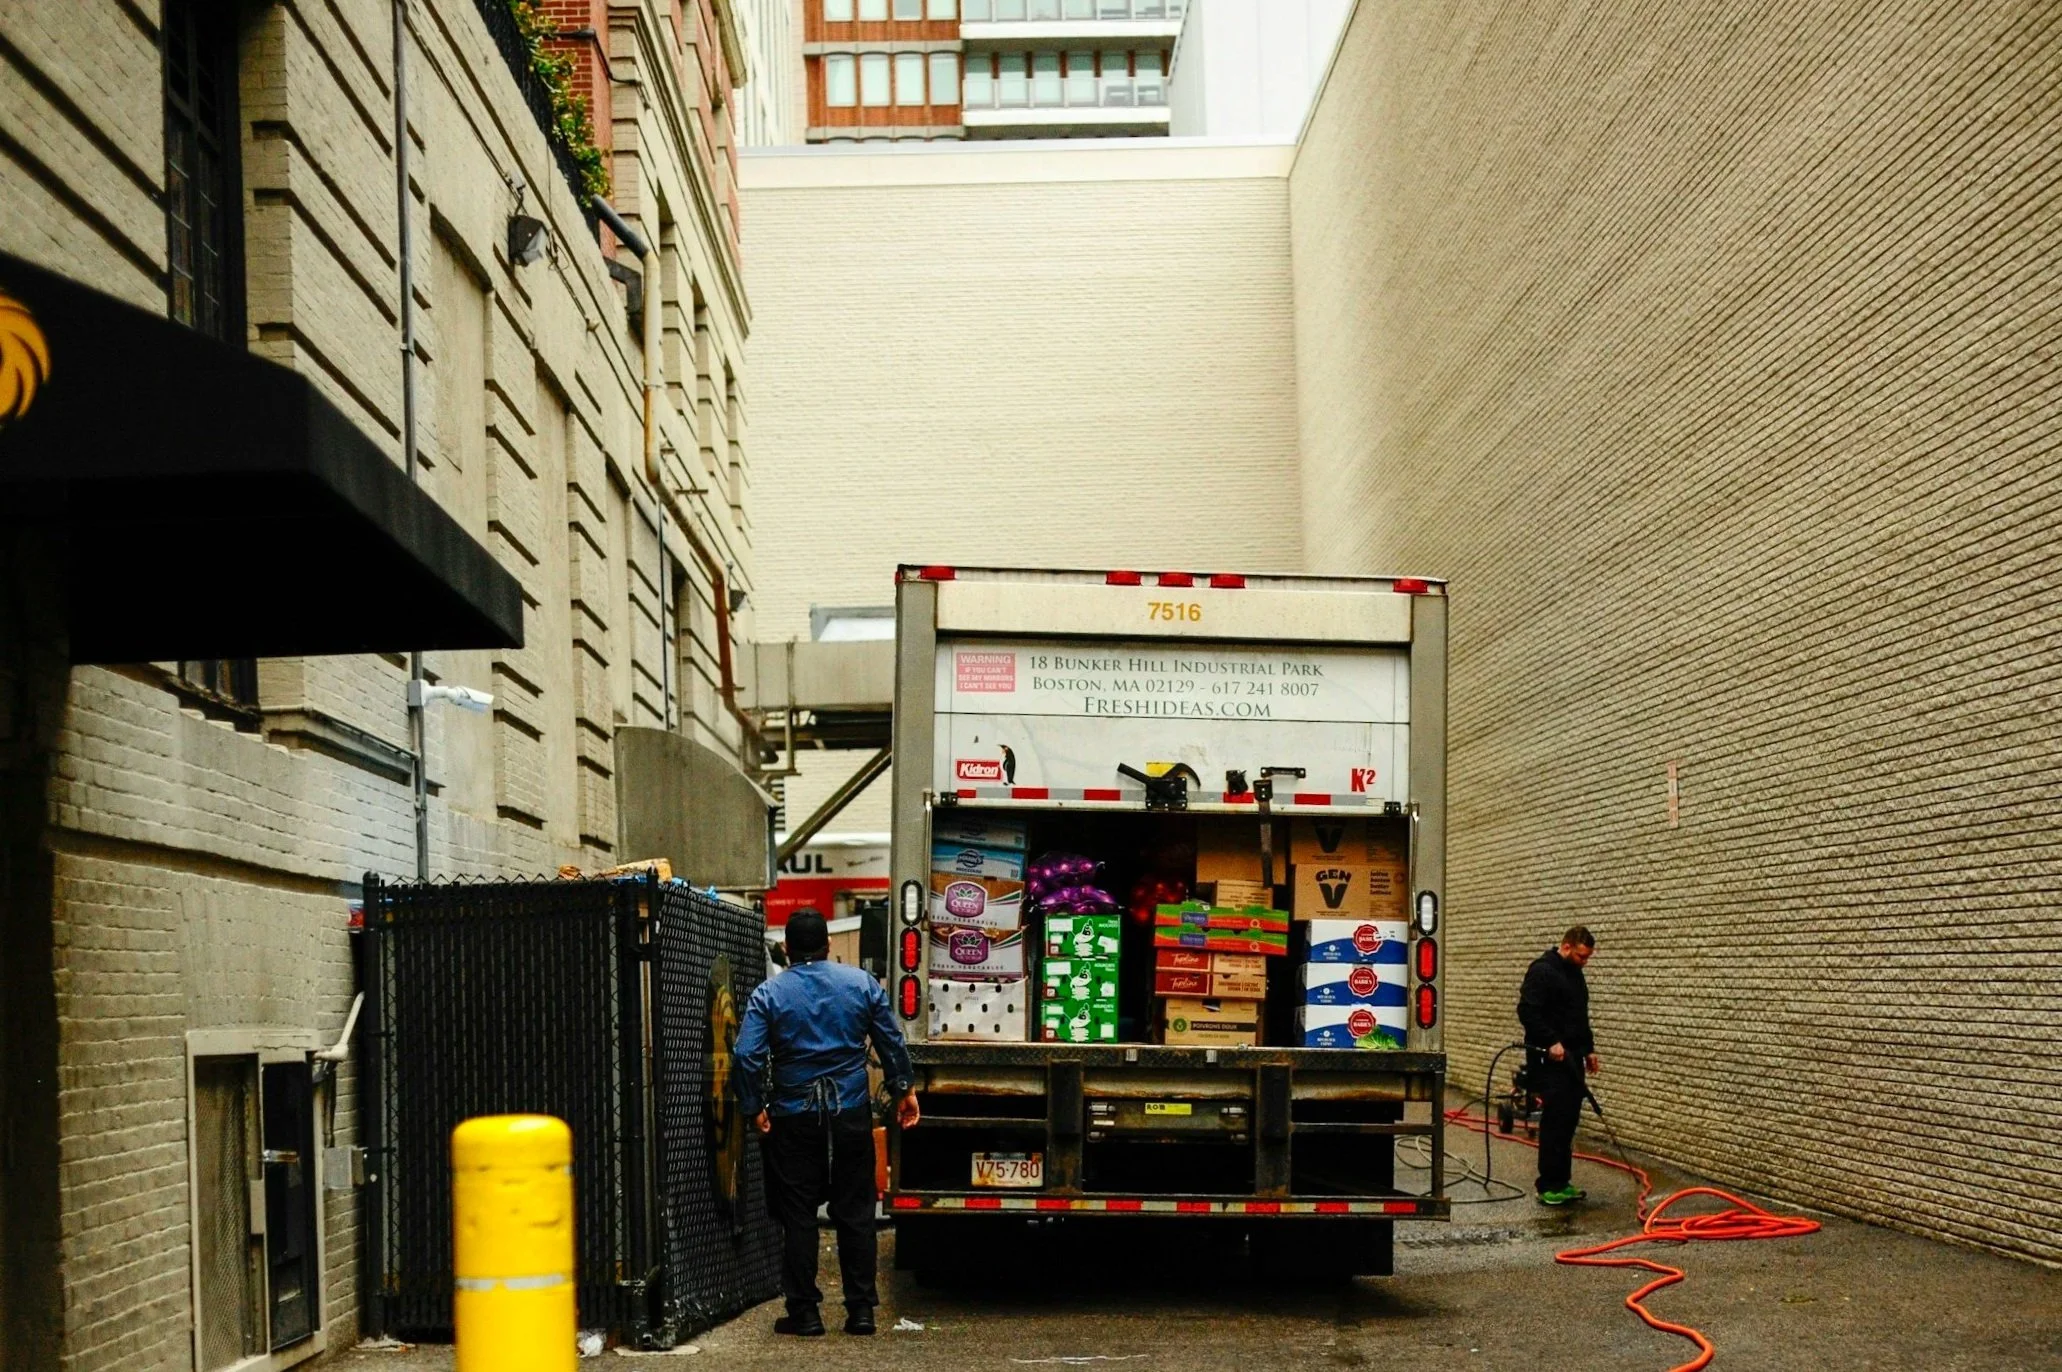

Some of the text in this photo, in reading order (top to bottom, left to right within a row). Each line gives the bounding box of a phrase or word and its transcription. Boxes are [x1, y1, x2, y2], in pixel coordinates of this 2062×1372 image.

[1147, 602, 1202, 622] 7516
[960, 655, 1011, 664] WARNING
[1030, 656, 1324, 676] 18 BUNKER HILL INDUSTRIAL PARK
[1033, 676, 1106, 692] BOSTON,
[1112, 679, 1141, 692] MA
[1145, 679, 1195, 693] 02129
[1212, 681, 1240, 695] 617
[1246, 682, 1273, 695] 241
[1280, 682, 1319, 696] 8007
[1084, 696, 1271, 718] FRESHIDEAS.COM
[959, 763, 999, 777] Kidron
[1316, 869, 1352, 882] GEN
[951, 900, 979, 910] QUEEN
[954, 947, 982, 956] QUEEN
